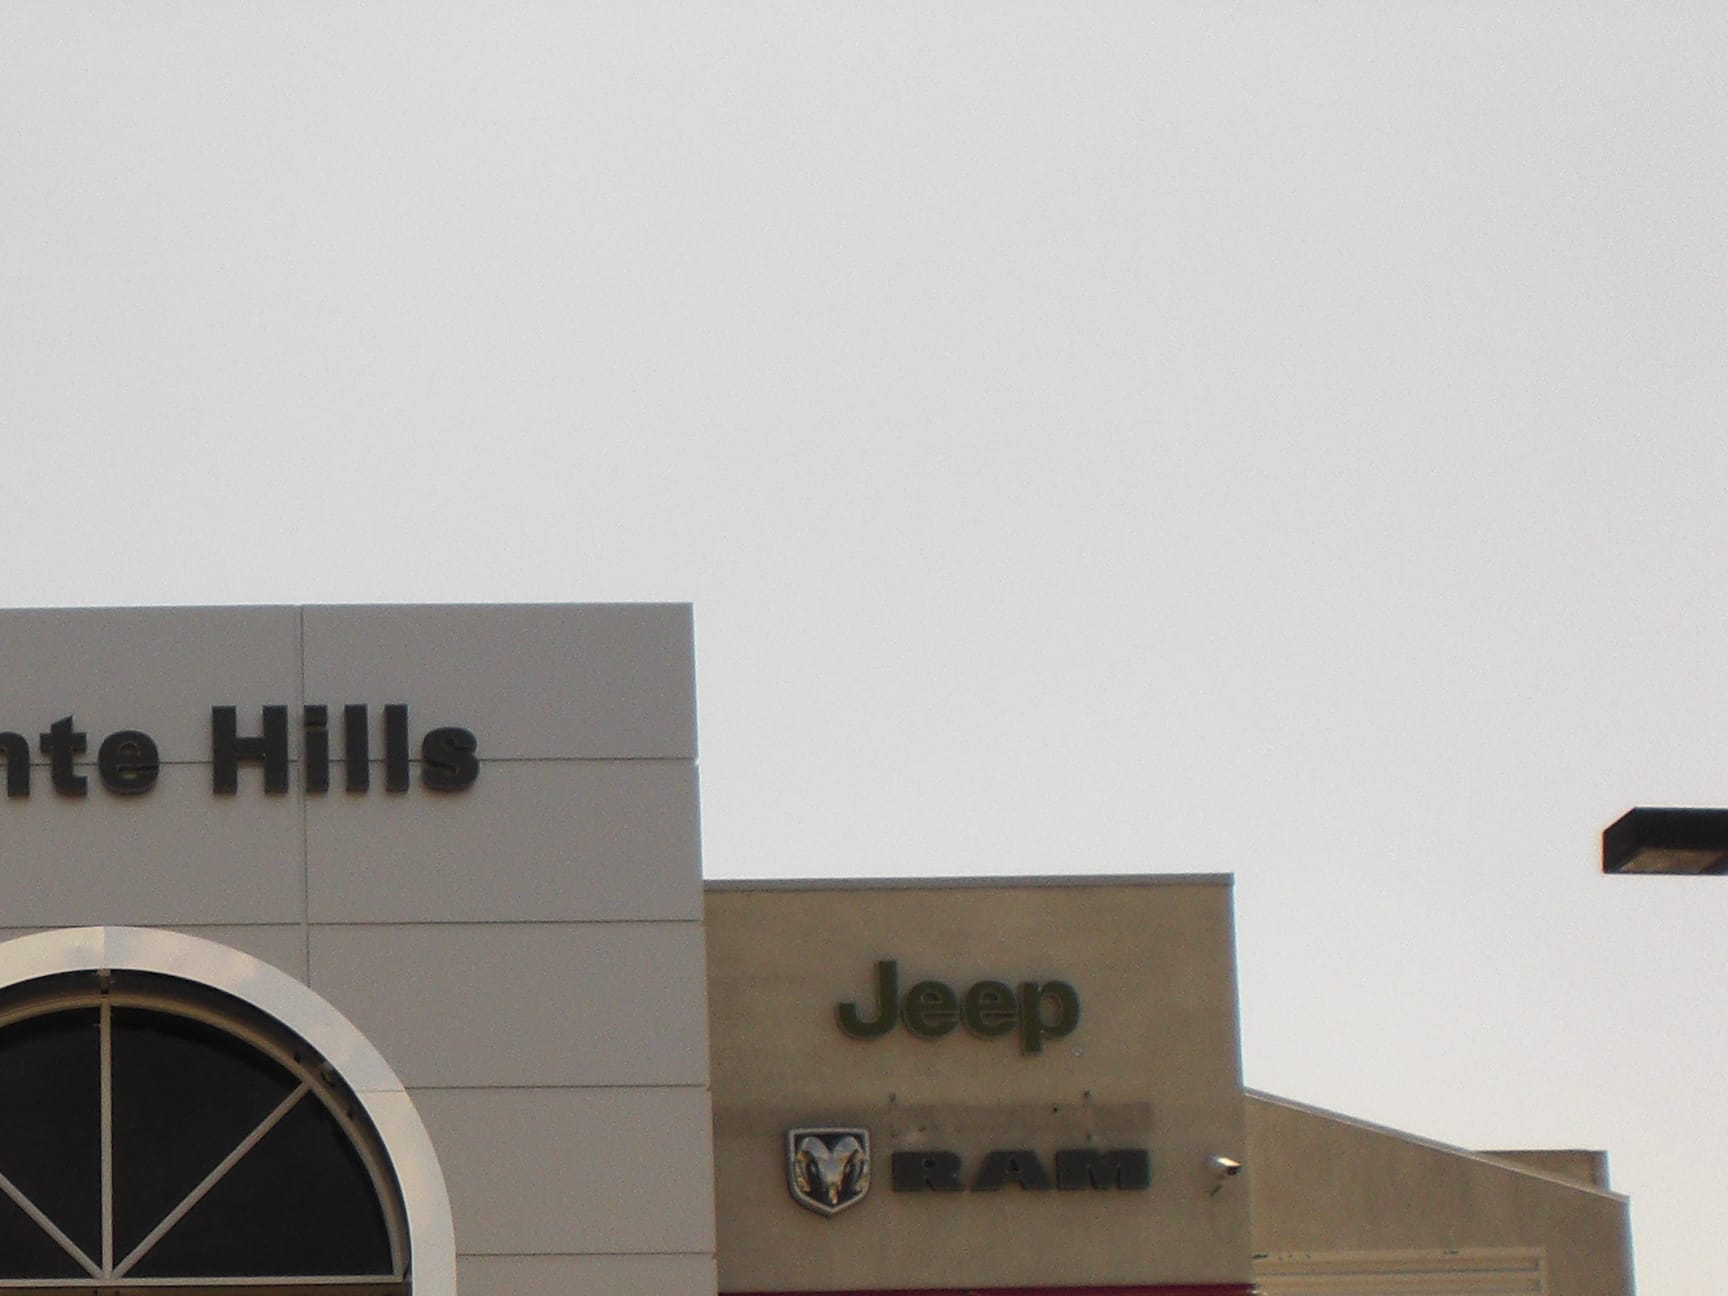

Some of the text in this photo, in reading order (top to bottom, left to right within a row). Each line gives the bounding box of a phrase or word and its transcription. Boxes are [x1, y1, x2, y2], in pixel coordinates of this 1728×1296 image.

[212, 703, 481, 795] Hills
[835, 959, 1081, 1056] Jeep
[892, 1148, 1151, 1192] RAM
